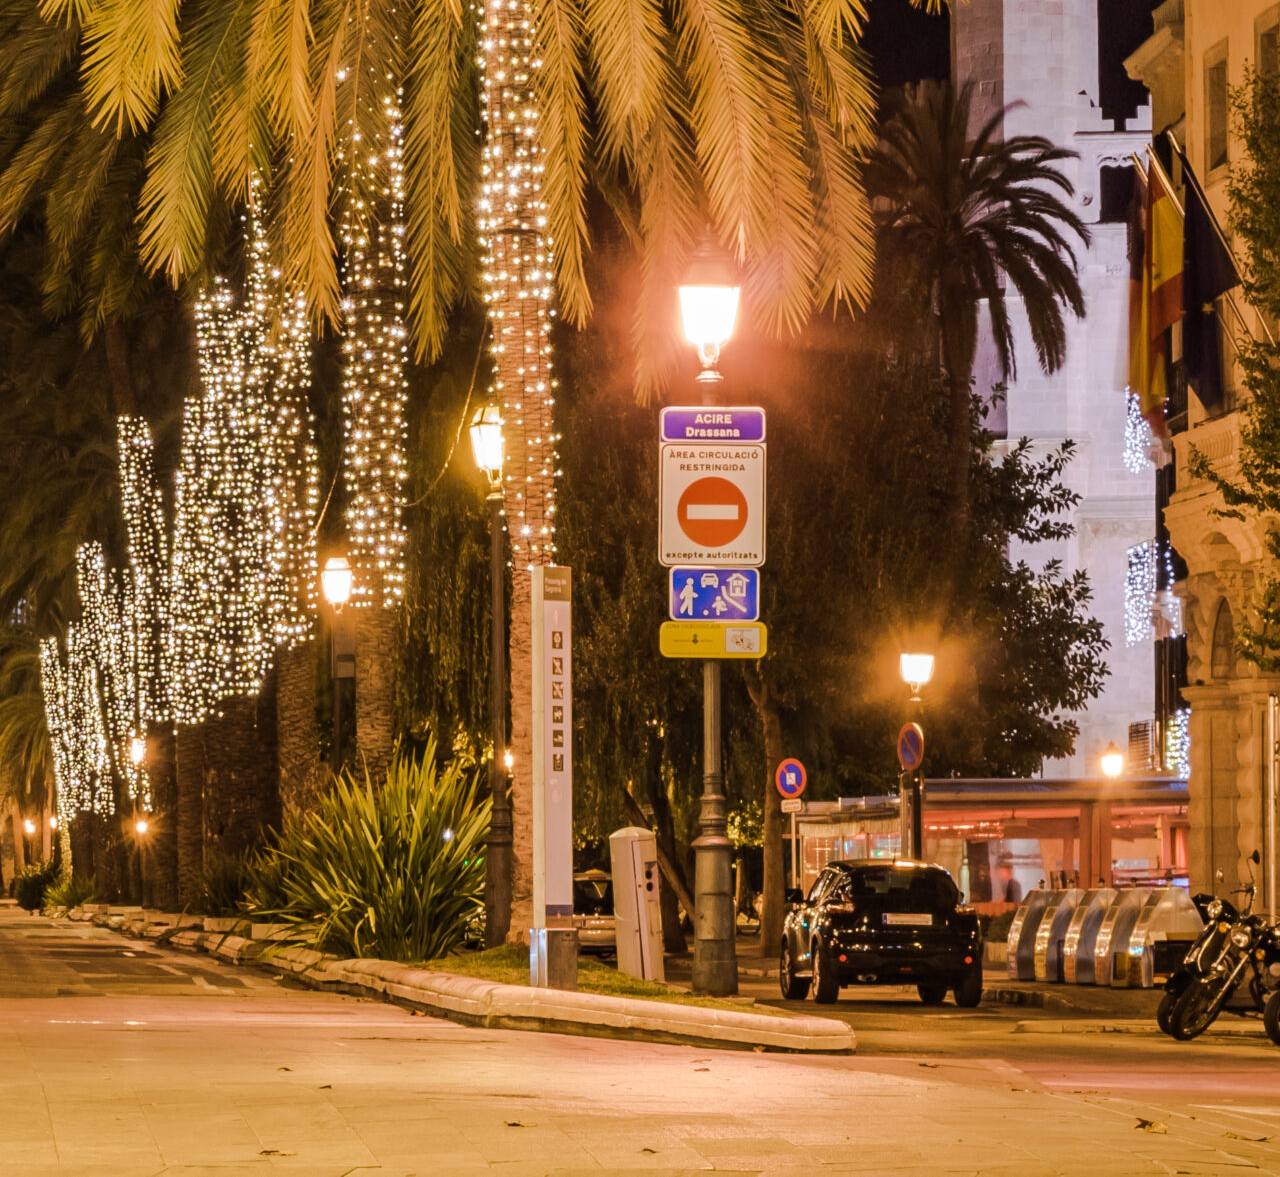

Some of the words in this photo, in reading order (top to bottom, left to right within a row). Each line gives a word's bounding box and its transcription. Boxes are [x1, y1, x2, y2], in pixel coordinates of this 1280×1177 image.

[695, 414, 732, 424] ACIRE
[685, 426, 740, 437] Drassana
[669, 449, 695, 459] ÀREA
[698, 449, 758, 459] CIRCULACIÓ
[680, 463, 745, 471] RESTRINGIDA
[666, 551, 703, 559] excepte
[706, 550, 758, 559] autoritzats
